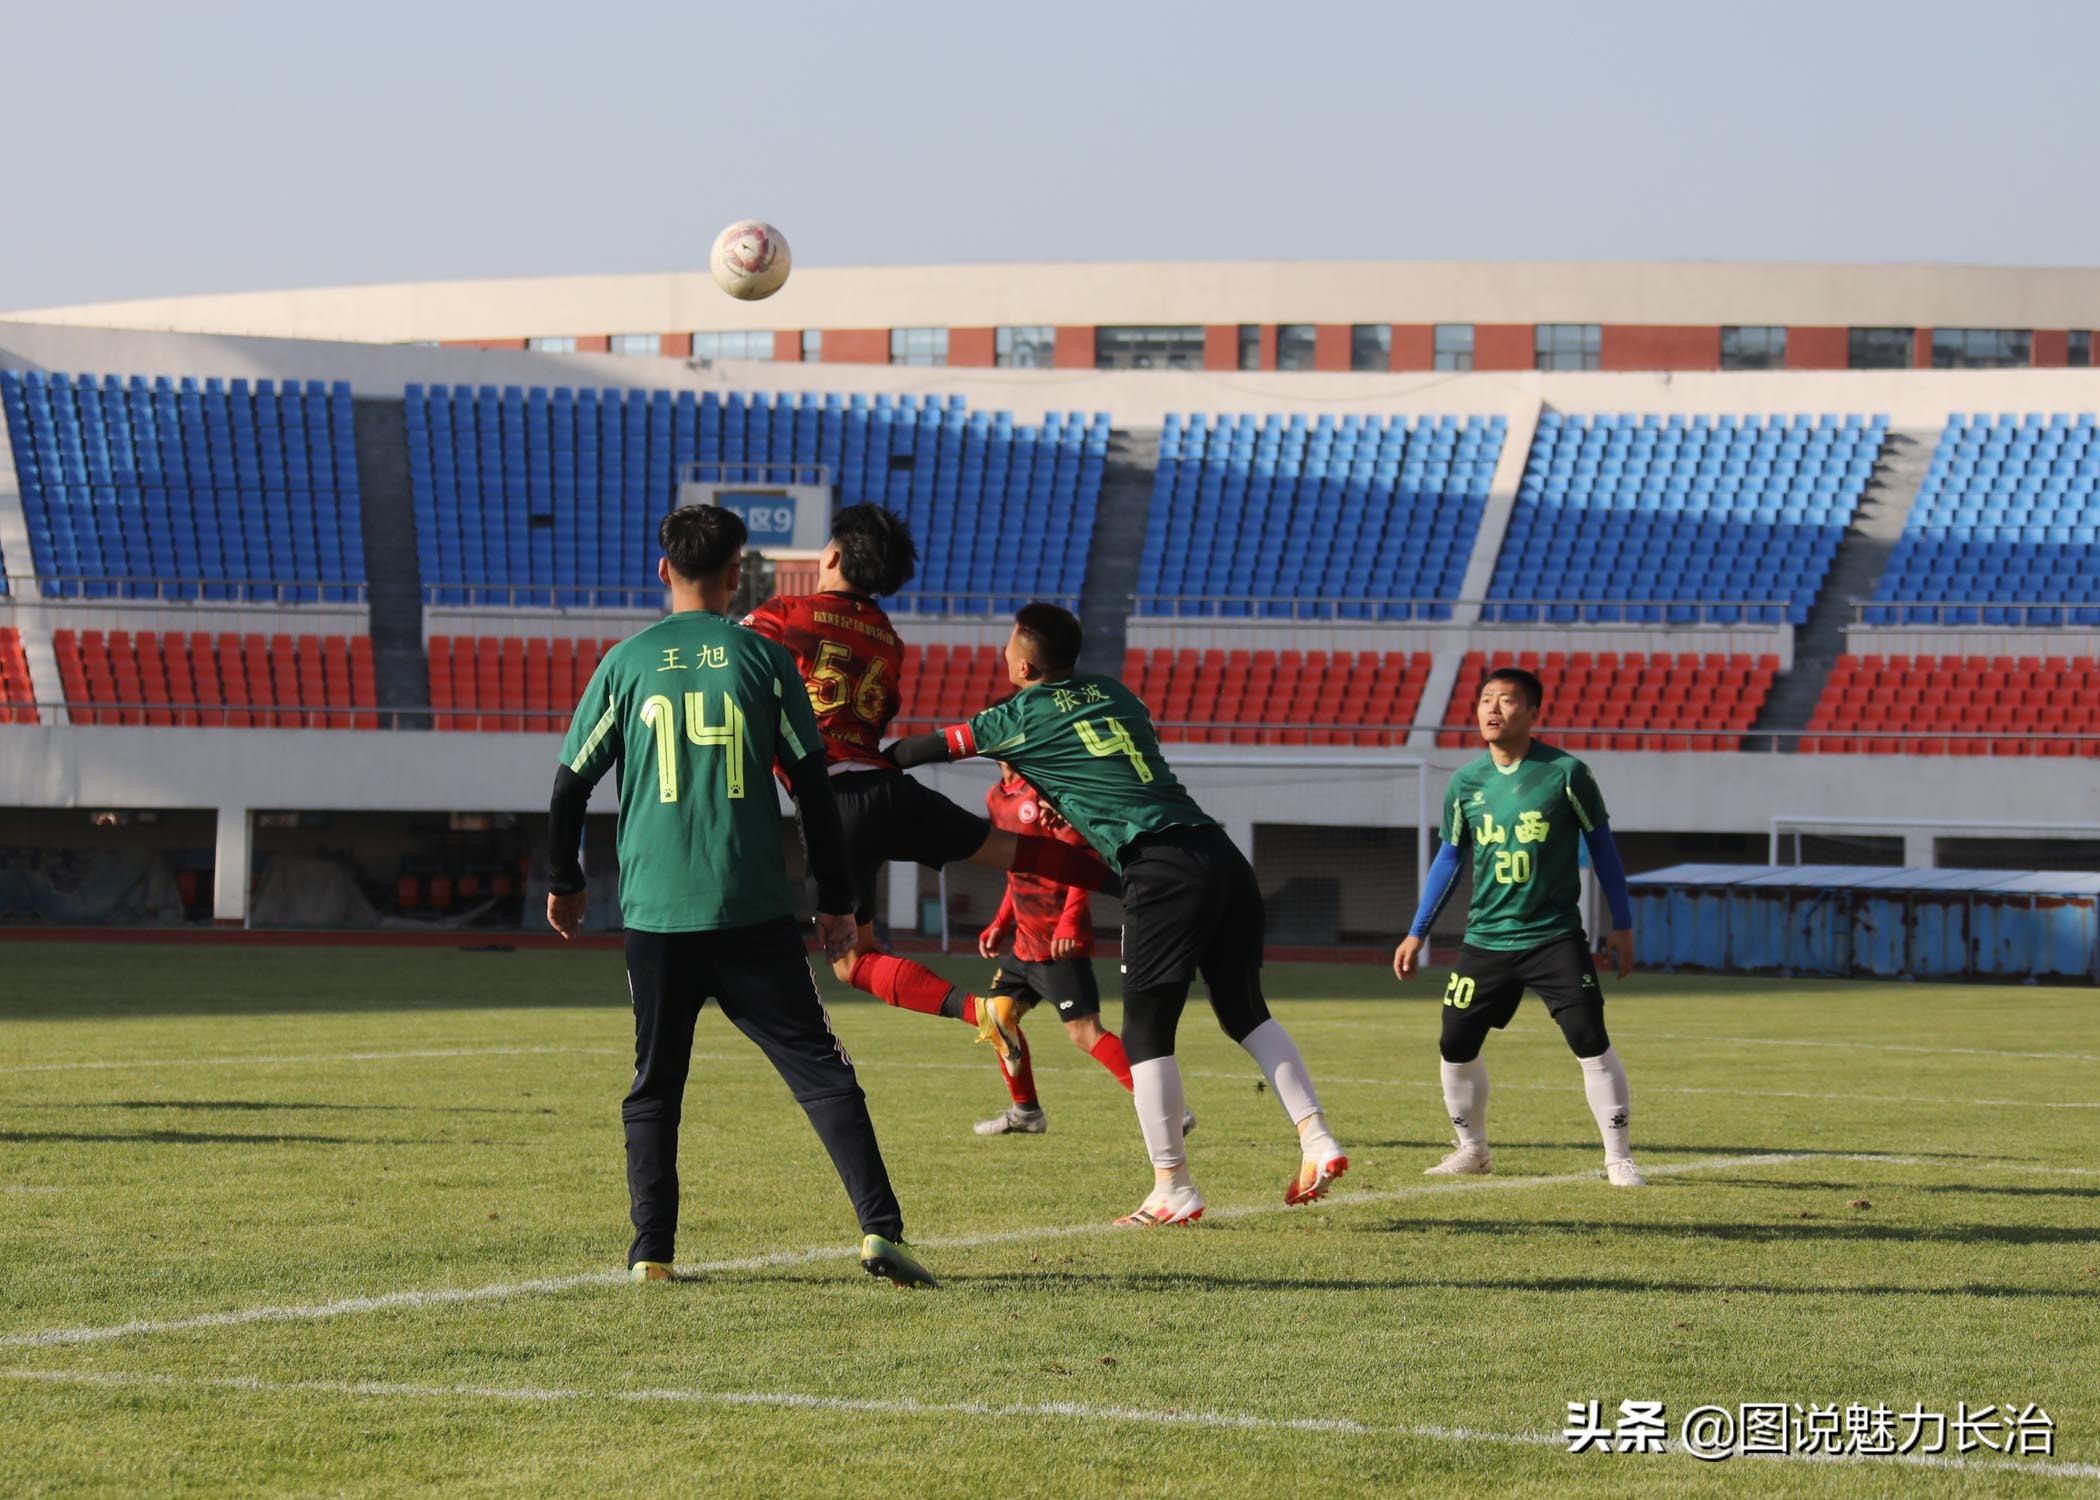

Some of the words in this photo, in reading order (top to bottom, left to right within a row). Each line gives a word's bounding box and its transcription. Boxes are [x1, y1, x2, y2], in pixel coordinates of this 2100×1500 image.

[725, 505, 793, 533] 区9
[656, 643, 729, 673] 王旭
[806, 640, 890, 721] 56
[1052, 684, 1110, 713] 张波
[639, 691, 745, 804] 14
[1073, 716, 1153, 784] 4
[1476, 811, 1551, 846] 山西
[1495, 850, 1530, 884] 20
[1443, 972, 1476, 1010] 20
